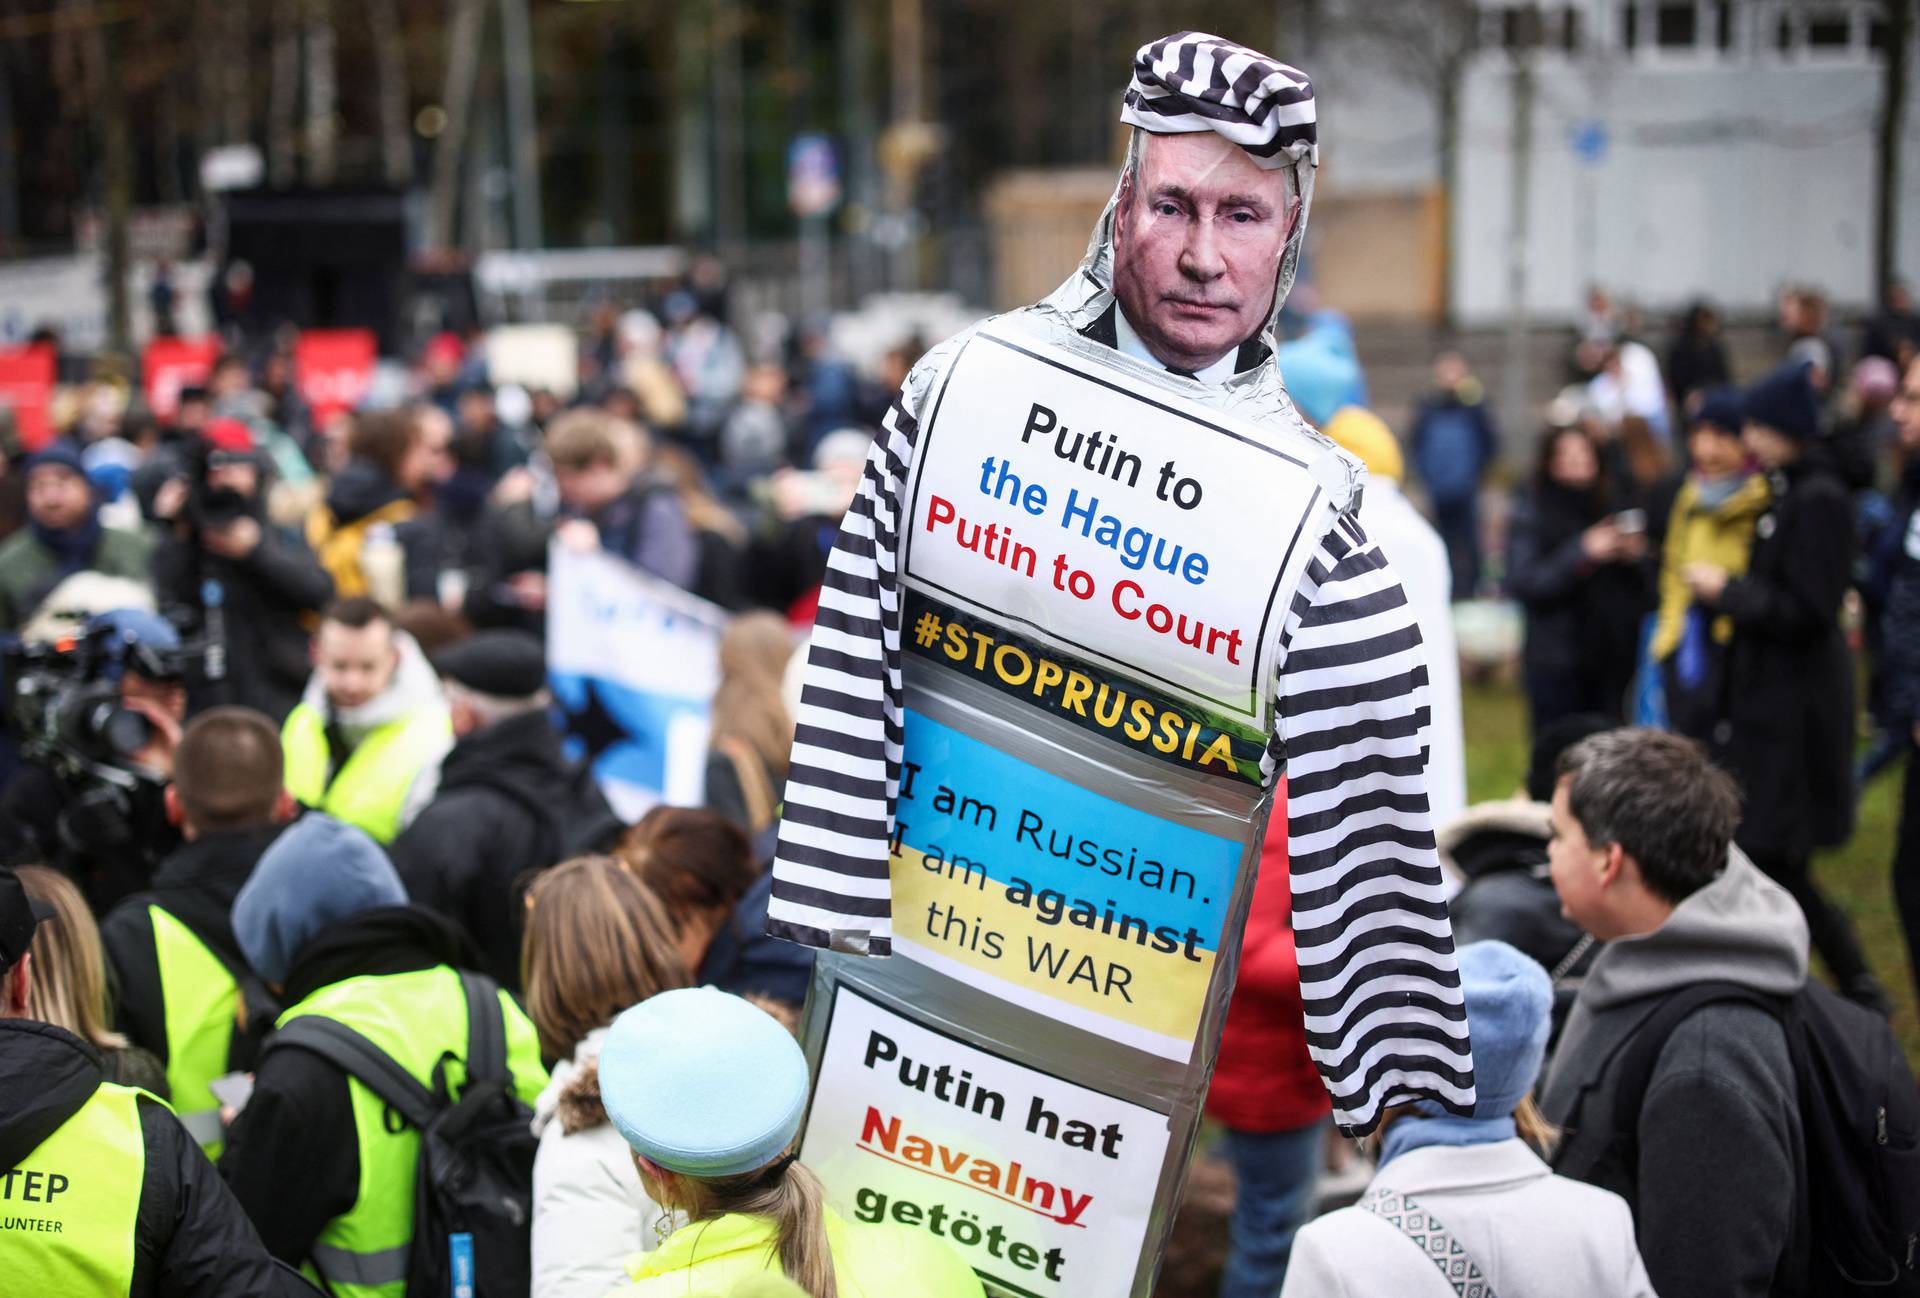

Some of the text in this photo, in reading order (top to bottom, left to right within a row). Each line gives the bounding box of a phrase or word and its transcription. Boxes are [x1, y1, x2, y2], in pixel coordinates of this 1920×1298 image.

[980, 455, 1210, 585] the Hague
[1021, 402, 1203, 510] Putin to
[926, 494, 1243, 666] Putin to Court
[914, 612, 1239, 773] #STOPRUSSIA
[888, 820, 1204, 963] I am against
[900, 761, 1210, 903] I am Russian.
[926, 901, 1133, 1004] this WAR
[863, 1030, 1124, 1160] Putin hat
[859, 1106, 1093, 1226] Navalny
[854, 1185, 1066, 1284] getötet
